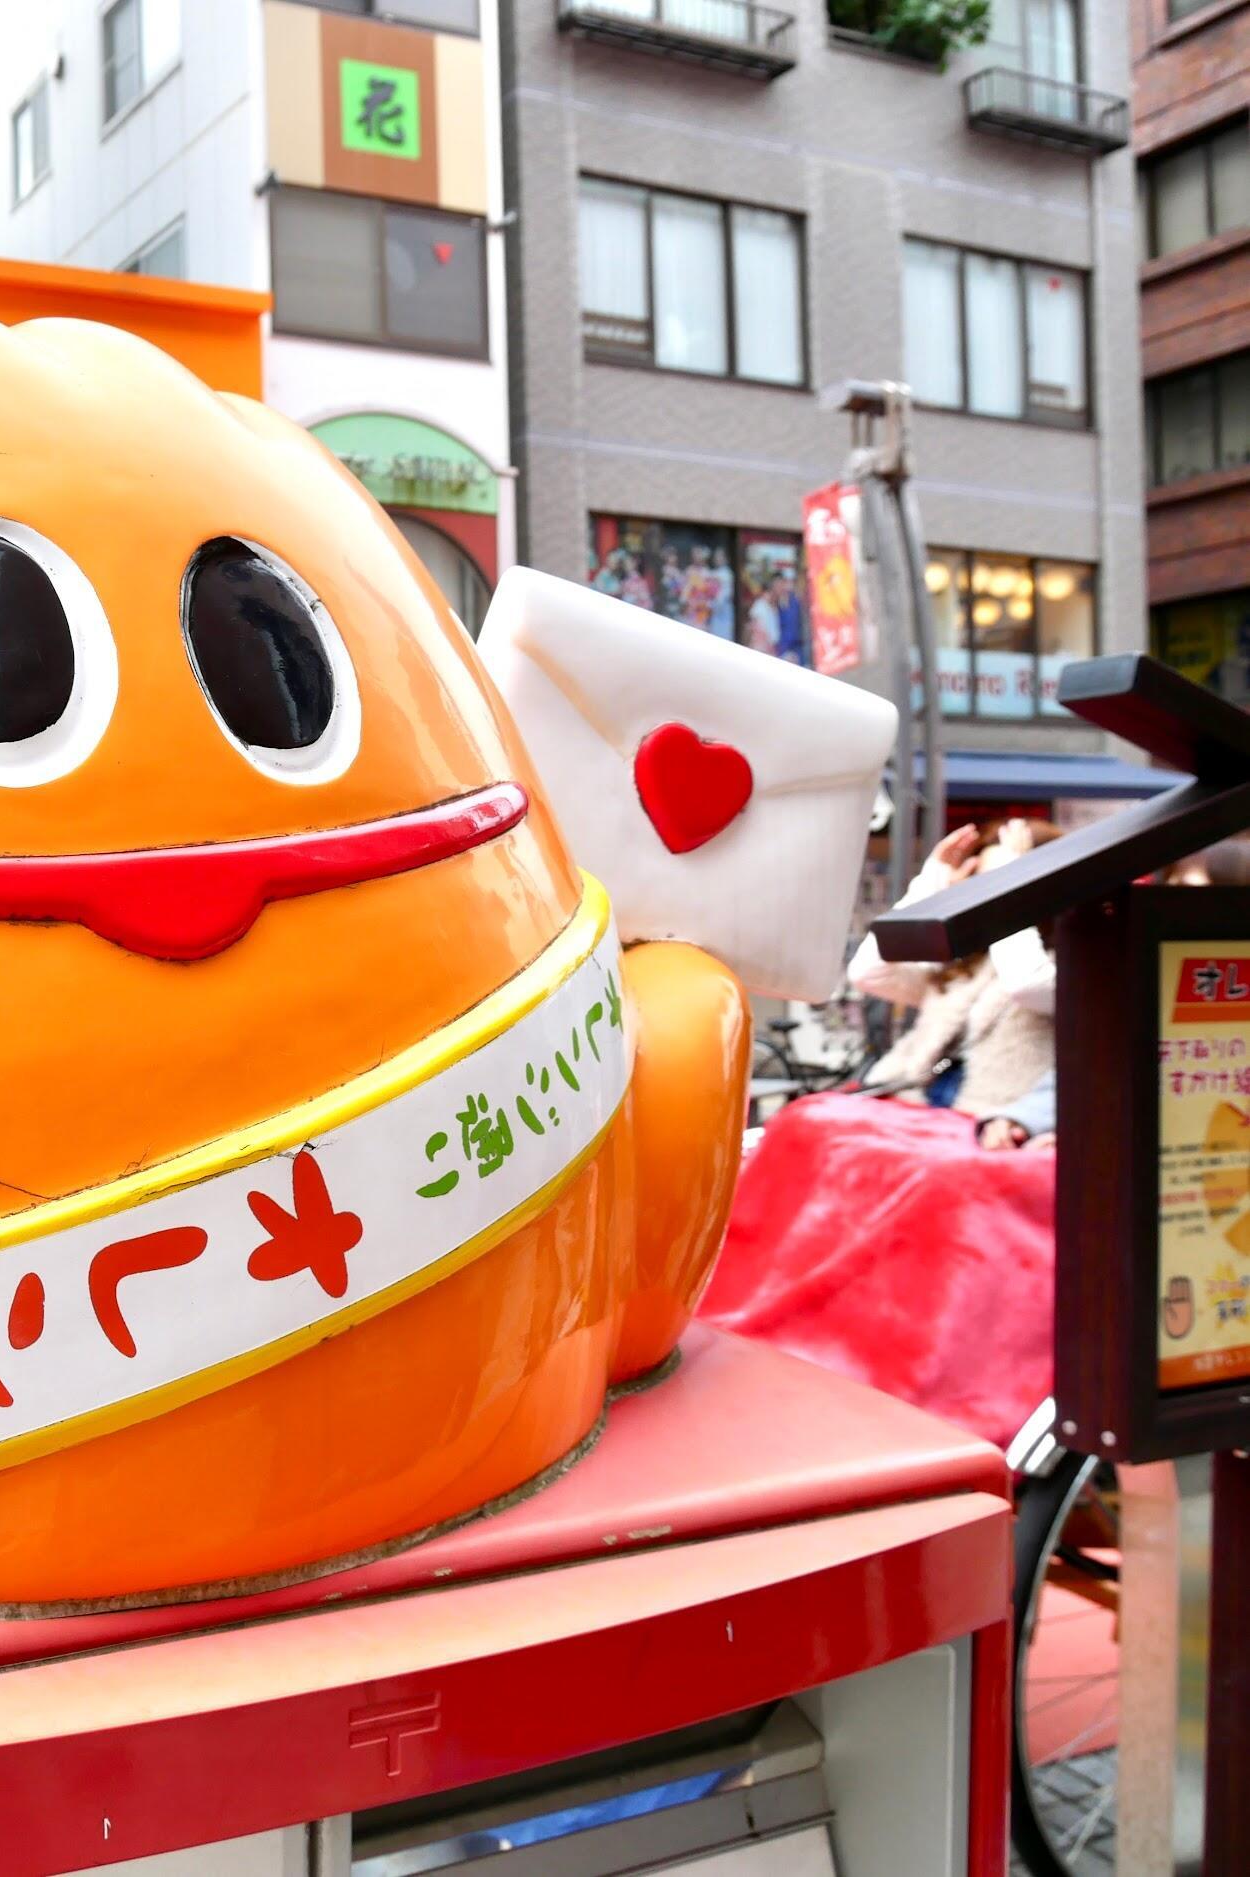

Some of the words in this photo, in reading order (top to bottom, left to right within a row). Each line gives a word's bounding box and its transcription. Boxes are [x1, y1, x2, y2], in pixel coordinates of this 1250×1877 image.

[356, 75, 406, 145] 花
[416, 968, 624, 1198] オレンジ通り
